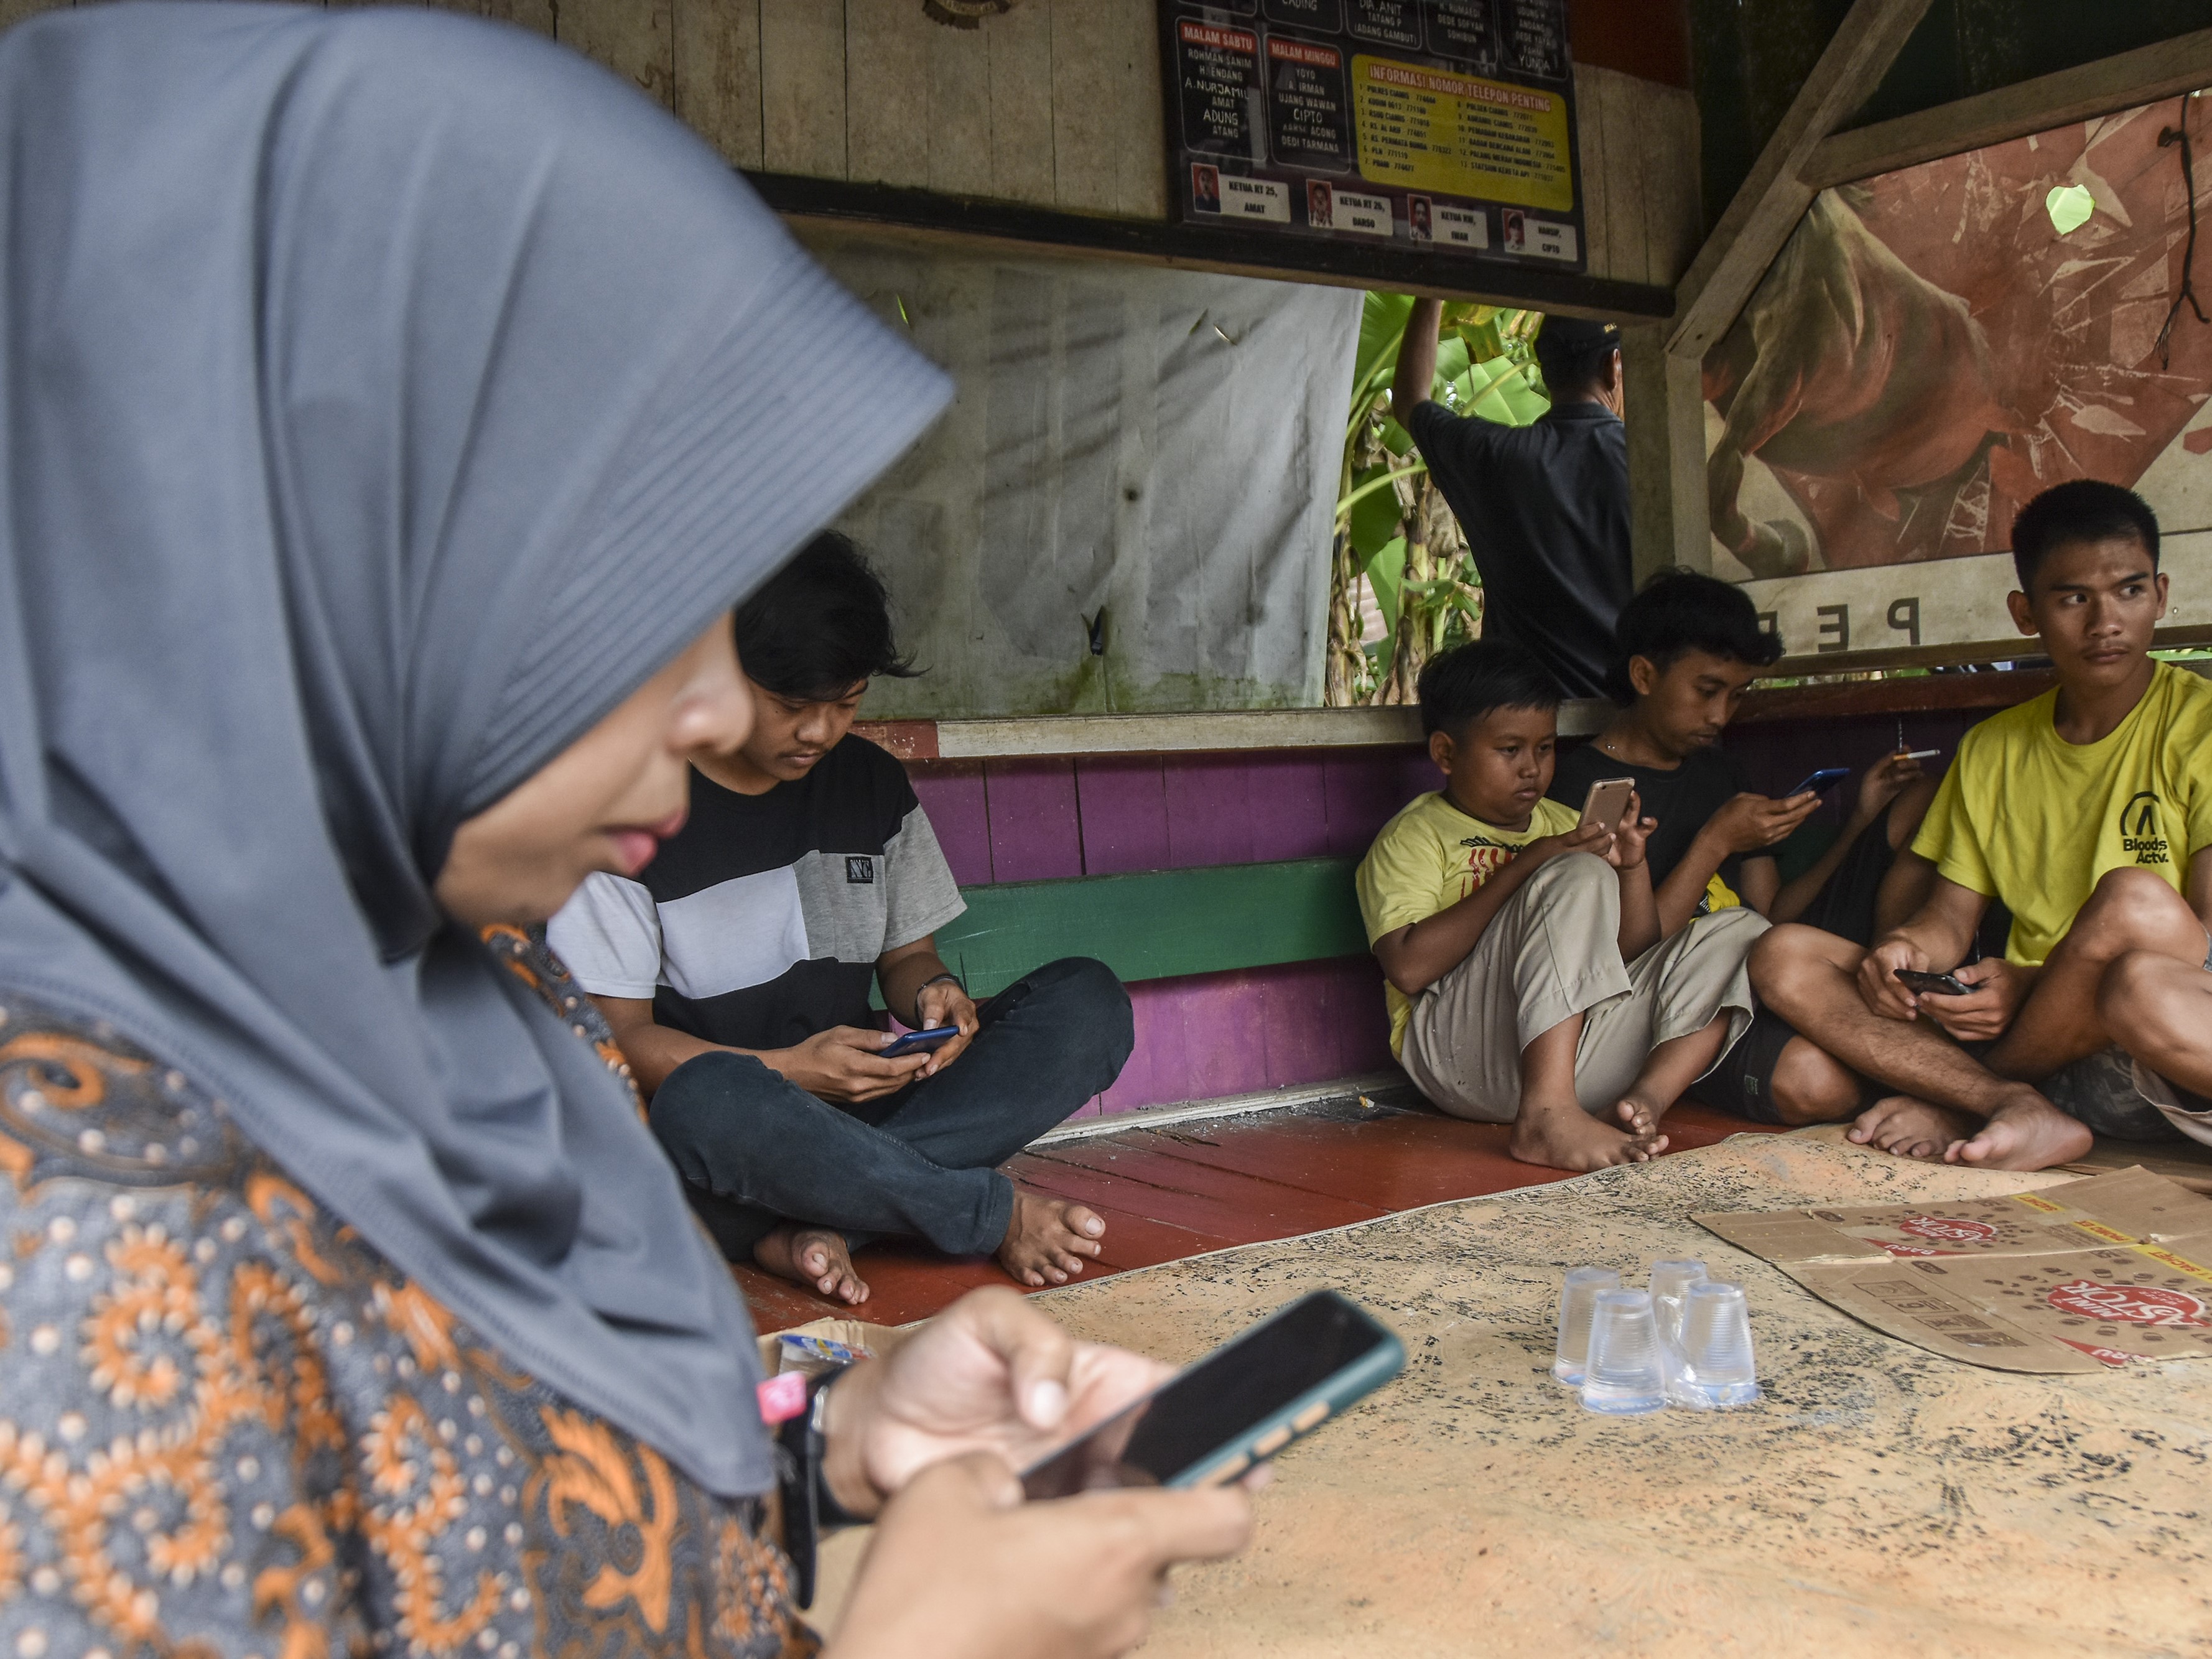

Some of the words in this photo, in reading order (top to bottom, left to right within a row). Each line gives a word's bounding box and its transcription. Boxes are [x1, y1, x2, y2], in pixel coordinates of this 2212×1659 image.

[1368, 11, 1395, 26] TATANG
[1396, 17, 1402, 27] P
[1184, 26, 1220, 44] MALAM
[1222, 30, 1253, 50] SABTU
[1187, 48, 1224, 64] ROHMAN
[1271, 43, 1303, 60] MALAM
[1304, 49, 1336, 65] MINGGU
[1211, 67, 1243, 82] ENDANG
[1295, 67, 1316, 80] YOYO
[1298, 82, 1325, 96] IRMAN
[1369, 64, 1426, 88] INFORMASI
[1428, 75, 1465, 95] NOMOR
[1467, 83, 1509, 104] TELEPON
[1510, 92, 1551, 112] PENTING
[1212, 96, 1235, 109] AMAT
[1278, 91, 1304, 106] UJANG
[1306, 97, 1336, 111] WAWAN
[1203, 108, 1238, 125] ADUNG
[1293, 108, 1323, 124] CIPTO
[1212, 124, 1239, 138] ATANG
[1310, 125, 1336, 139] ACONG
[1281, 135, 1299, 147] DEDI
[1302, 138, 1339, 154] TARMANA
[1229, 180, 1253, 193] KETUA
[1254, 184, 1264, 195] RT
[1265, 185, 1278, 197] 25,
[1244, 202, 1265, 213] AMAT
[1339, 196, 1363, 208] KETUA
[1363, 199, 1372, 209] RT
[1352, 217, 1375, 228] DARSO
[1441, 211, 1462, 222] KETUA
[2135, 851, 2169, 864] Actv.
[1907, 1225, 1945, 1238] MINI
[1908, 1216, 1993, 1242] ASTOR
[2089, 1227, 2131, 1242] PROMO
[1884, 1243, 1936, 1255] BARU
[2147, 1252, 2201, 1273] SACHET
[2060, 1281, 2203, 1326] ASTOR
[2063, 1296, 2124, 1318] MINI
